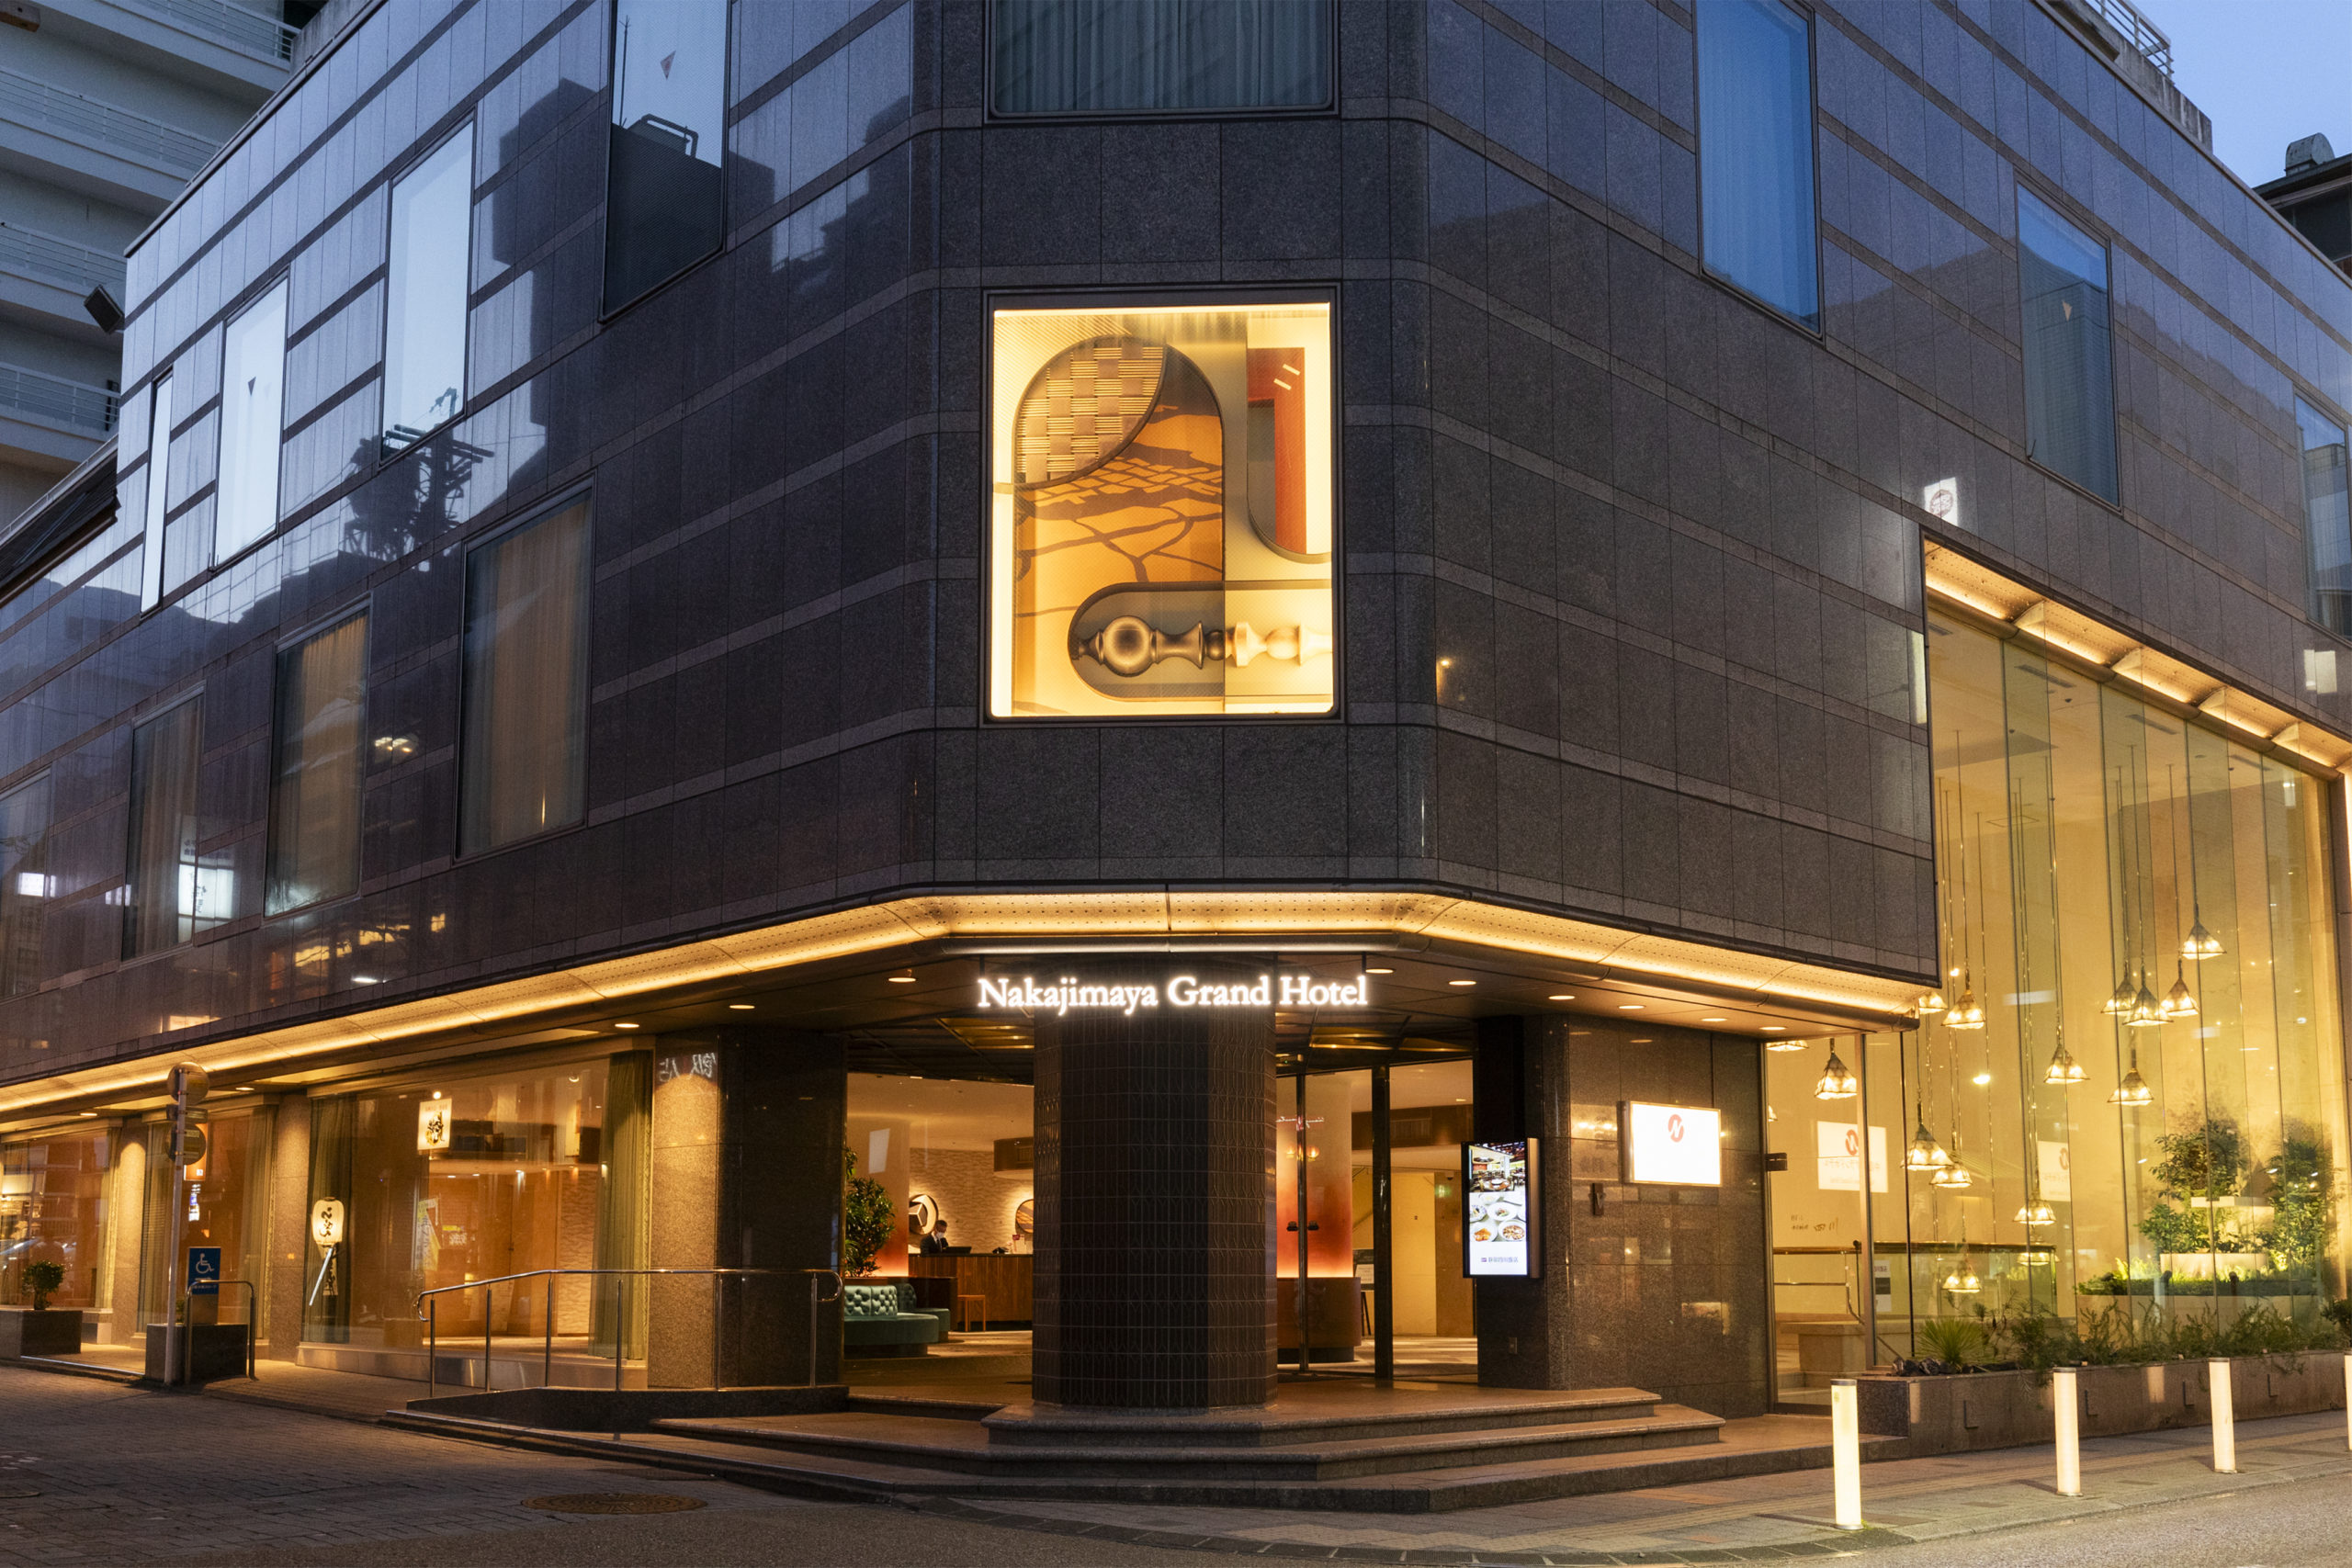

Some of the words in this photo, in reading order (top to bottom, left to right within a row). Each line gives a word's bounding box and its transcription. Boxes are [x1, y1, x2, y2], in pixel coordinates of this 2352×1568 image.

[977, 976, 1159, 1017] Nakajimaya
[1168, 975, 1272, 1007] Grand
[1278, 975, 1368, 1007] Hotel
